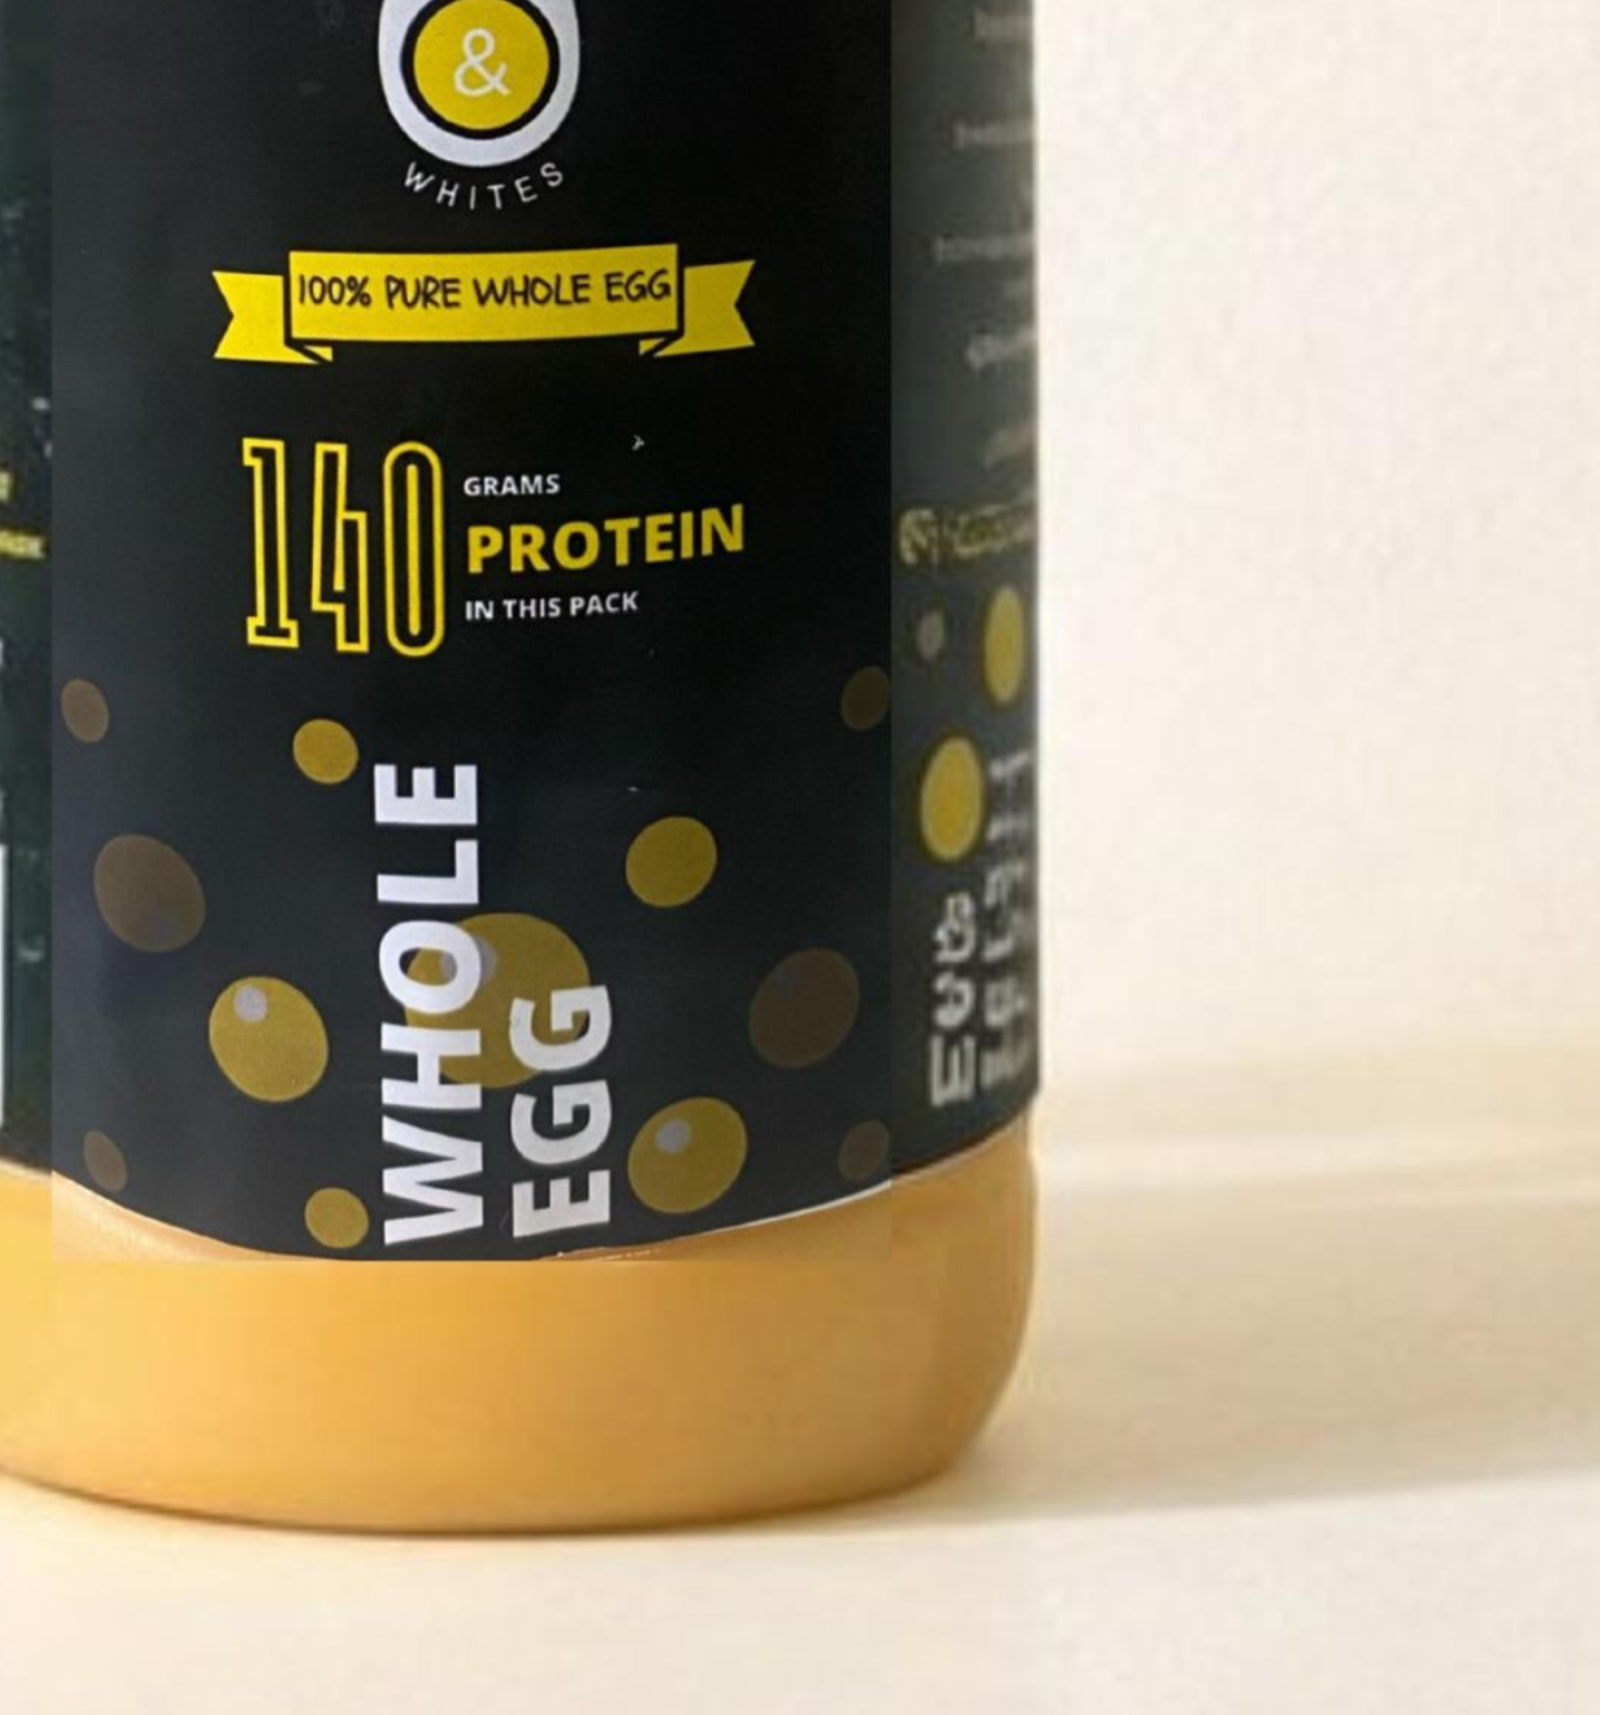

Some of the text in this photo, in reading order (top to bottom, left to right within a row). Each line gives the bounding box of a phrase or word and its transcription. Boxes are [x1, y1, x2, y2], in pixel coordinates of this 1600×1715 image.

[451, 24, 512, 98] &
[402, 159, 566, 212] WHITES
[298, 266, 674, 310] 100% PURE WHOLE EGG
[461, 472, 561, 498] GRAMS
[240, 435, 447, 659] 140
[466, 502, 745, 576] PROTEIN
[464, 590, 639, 622] IN THIS PACK
[372, 762, 485, 1247] WHOLE
[508, 985, 613, 1239] EGG
